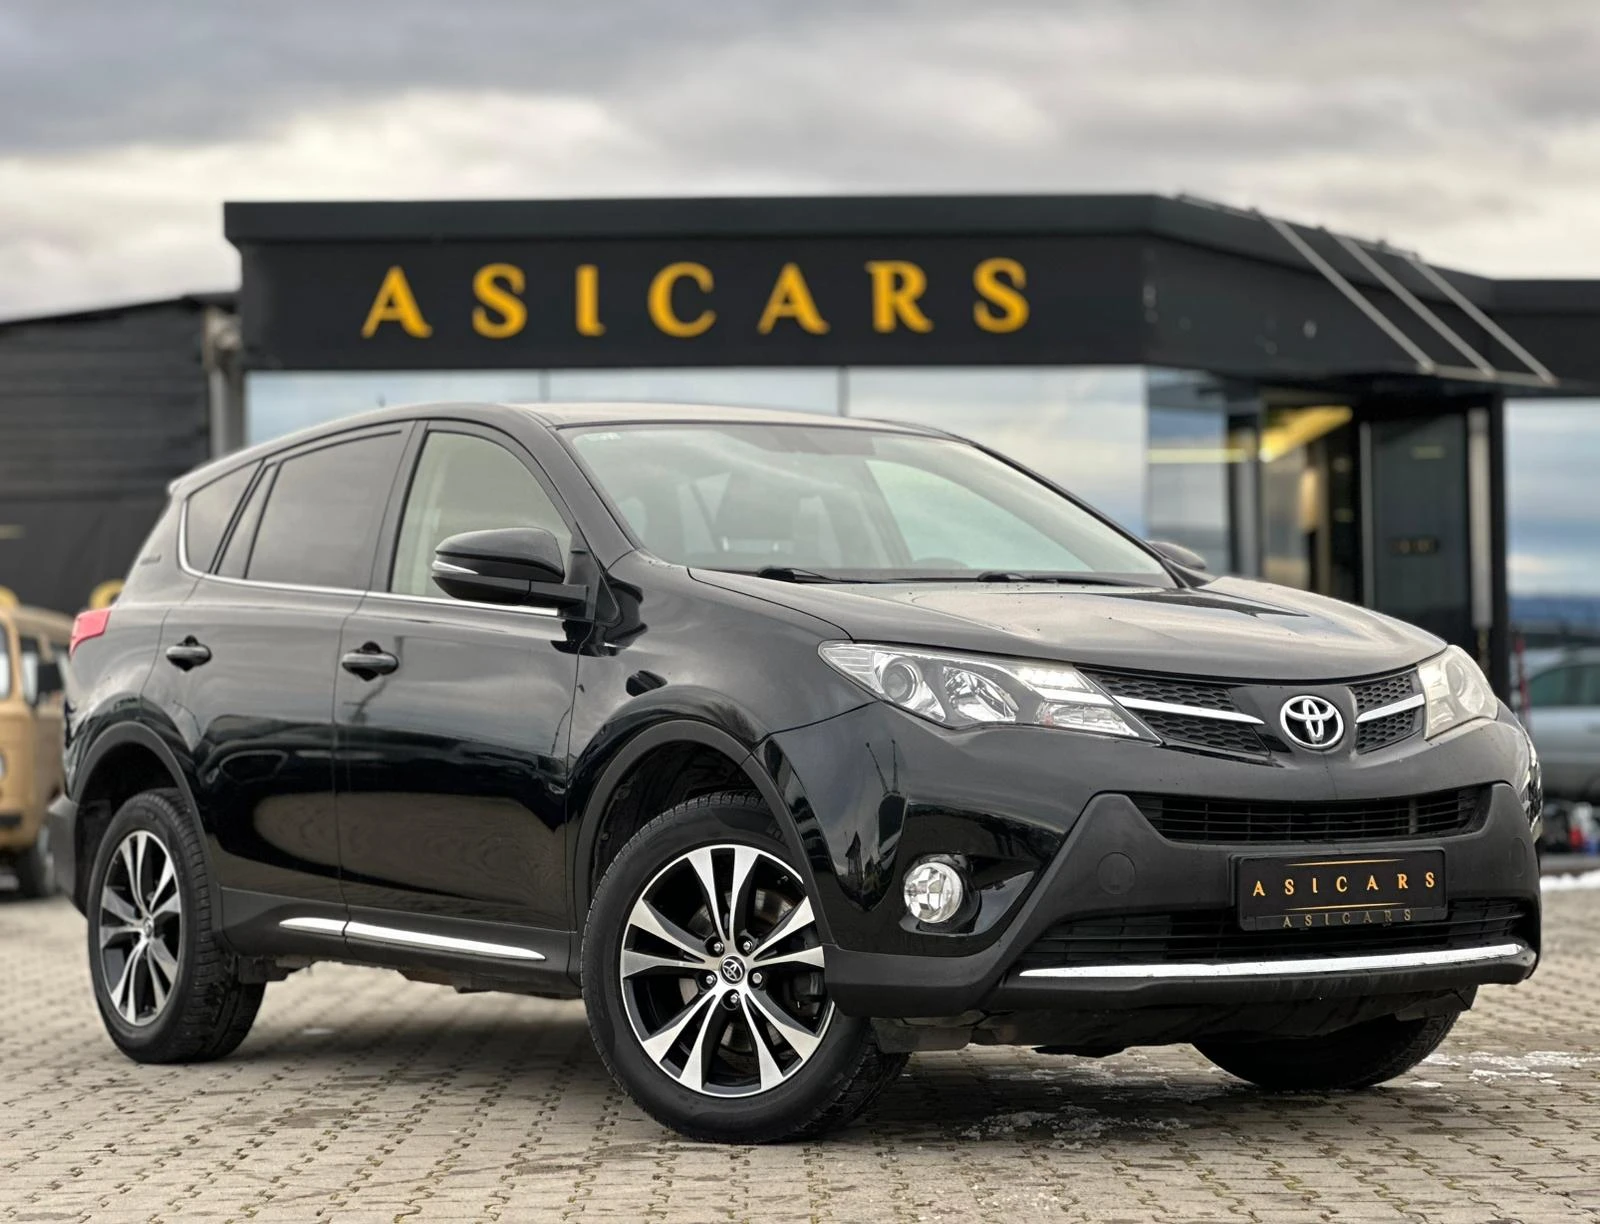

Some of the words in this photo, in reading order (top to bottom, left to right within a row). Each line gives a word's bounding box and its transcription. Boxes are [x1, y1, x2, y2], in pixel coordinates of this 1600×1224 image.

[361, 257, 1030, 338] ASICARS
[1252, 871, 1435, 897] ASICARS
[1282, 908, 1412, 928] ASICARS
